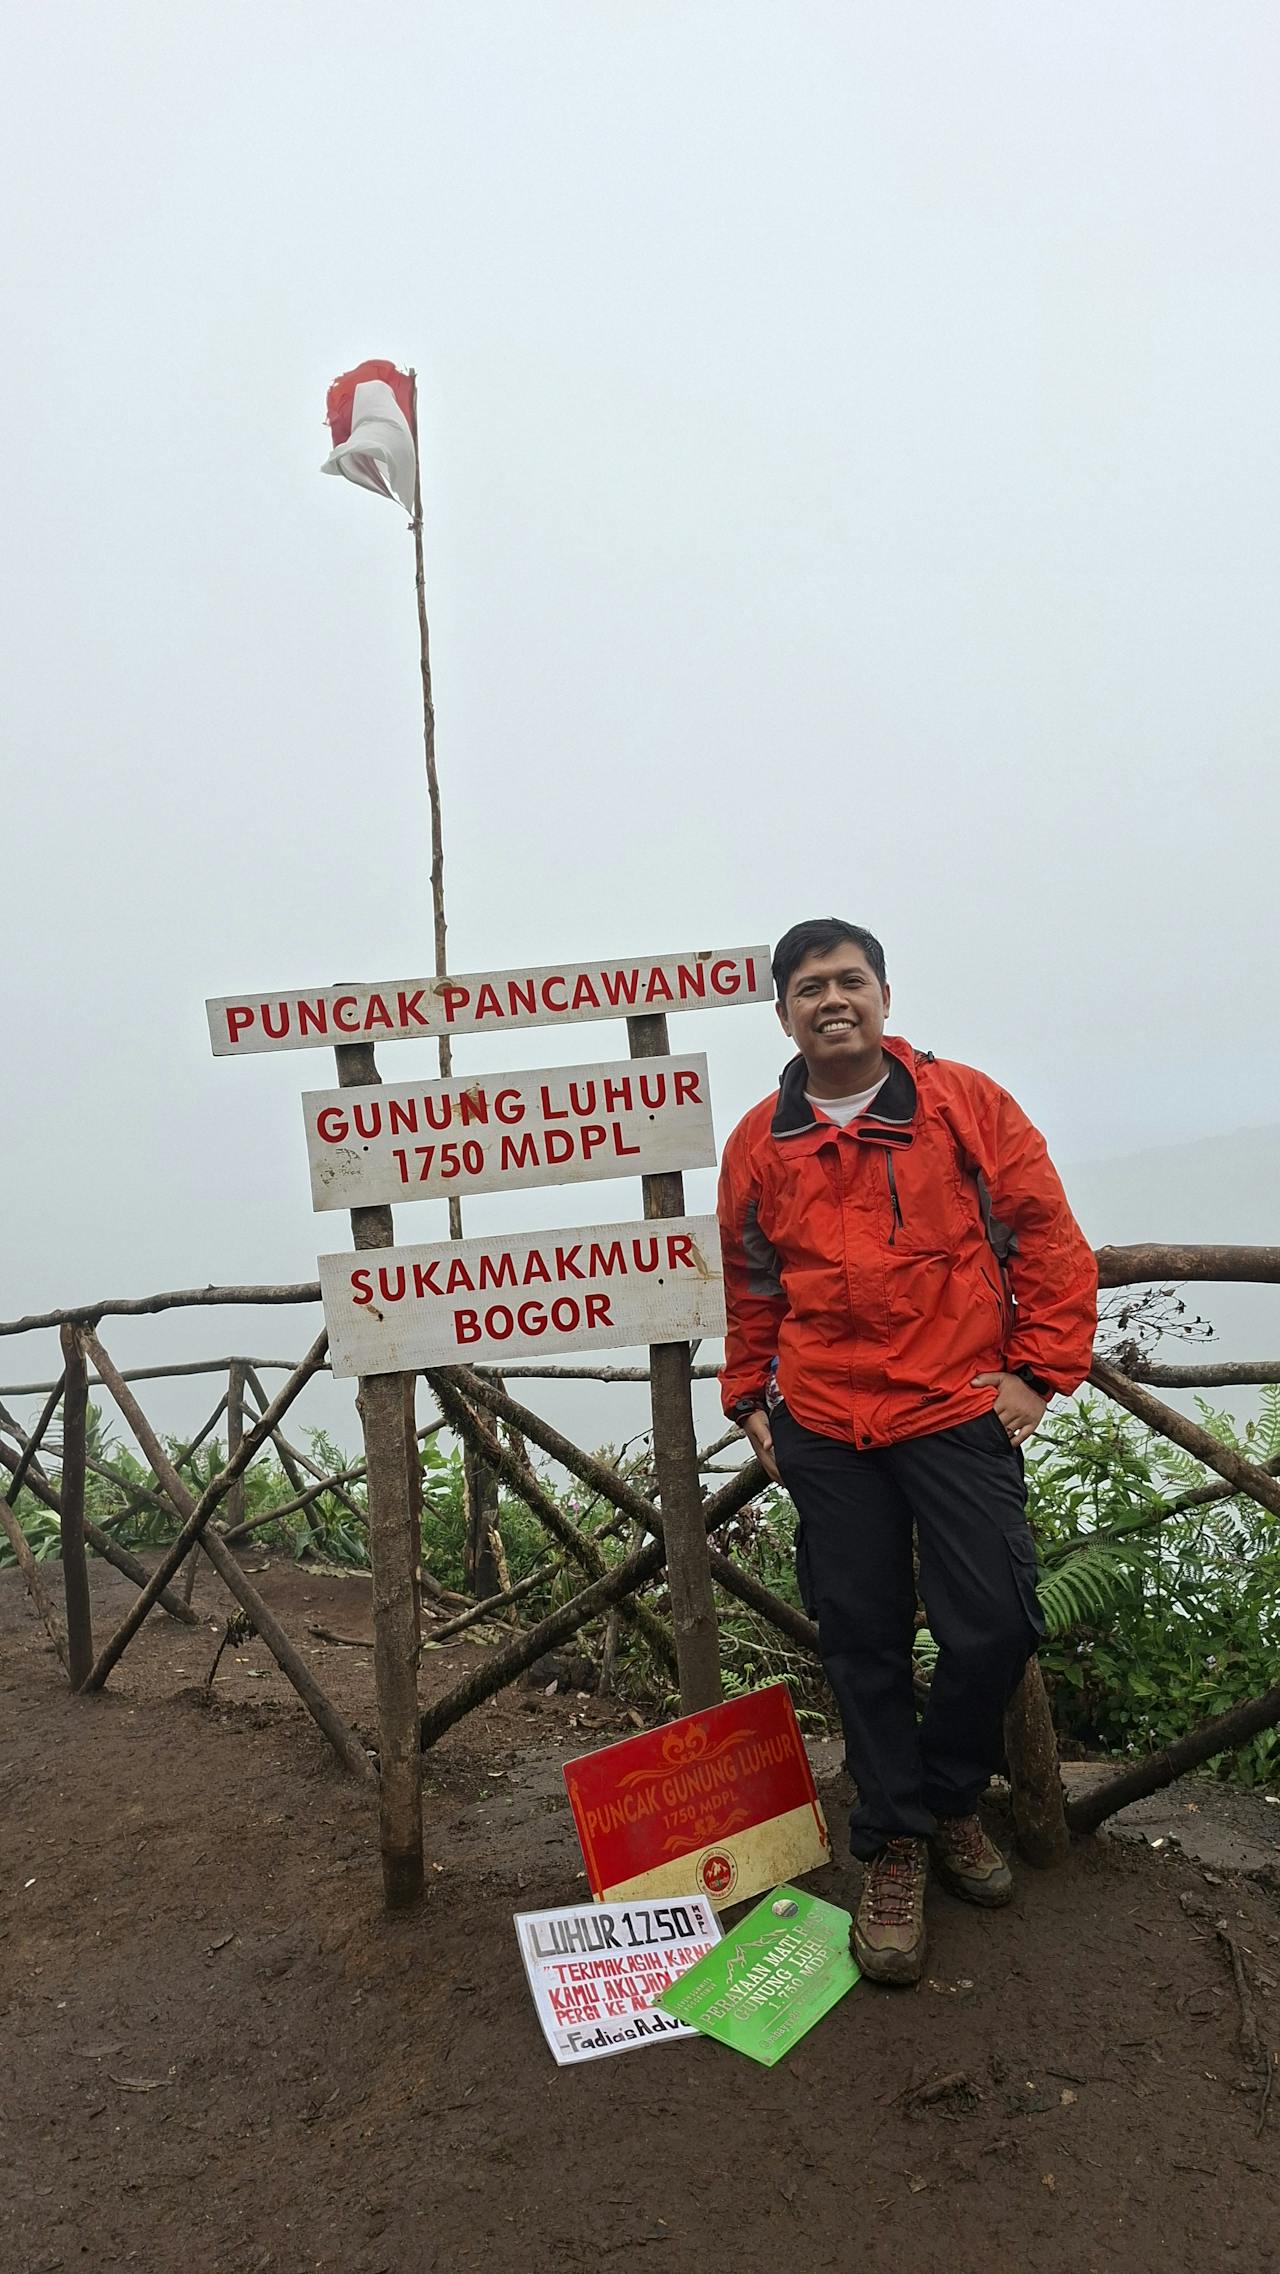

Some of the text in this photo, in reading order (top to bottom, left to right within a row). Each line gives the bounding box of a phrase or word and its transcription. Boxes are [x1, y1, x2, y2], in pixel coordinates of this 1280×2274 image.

[226, 958, 758, 1043] PUNCAK PANCAWANGI
[316, 1070, 705, 1144] GUNUNG LUHUR
[393, 1122, 641, 1184] 1750 MDPL
[351, 1234, 695, 1306] SUKAMAKMUR
[454, 1294, 613, 1345] BOGOR
[586, 1733, 796, 1838] PUNCAK GUNUNG LUHUR
[663, 1789, 739, 1830] 1750 MDPL
[529, 1914, 623, 1958] LUHUR
[691, 1904, 708, 1935] MDPL
[701, 1963, 772, 2027] PERAYAAN
[763, 1935, 802, 1967] MATI
[791, 1905, 831, 1938] RAS
[555, 2005, 602, 2027] PERGI
[604, 2000, 628, 2017] KE
[733, 1968, 793, 2021] GUNUNG
[768, 1978, 806, 2011] 1.750
